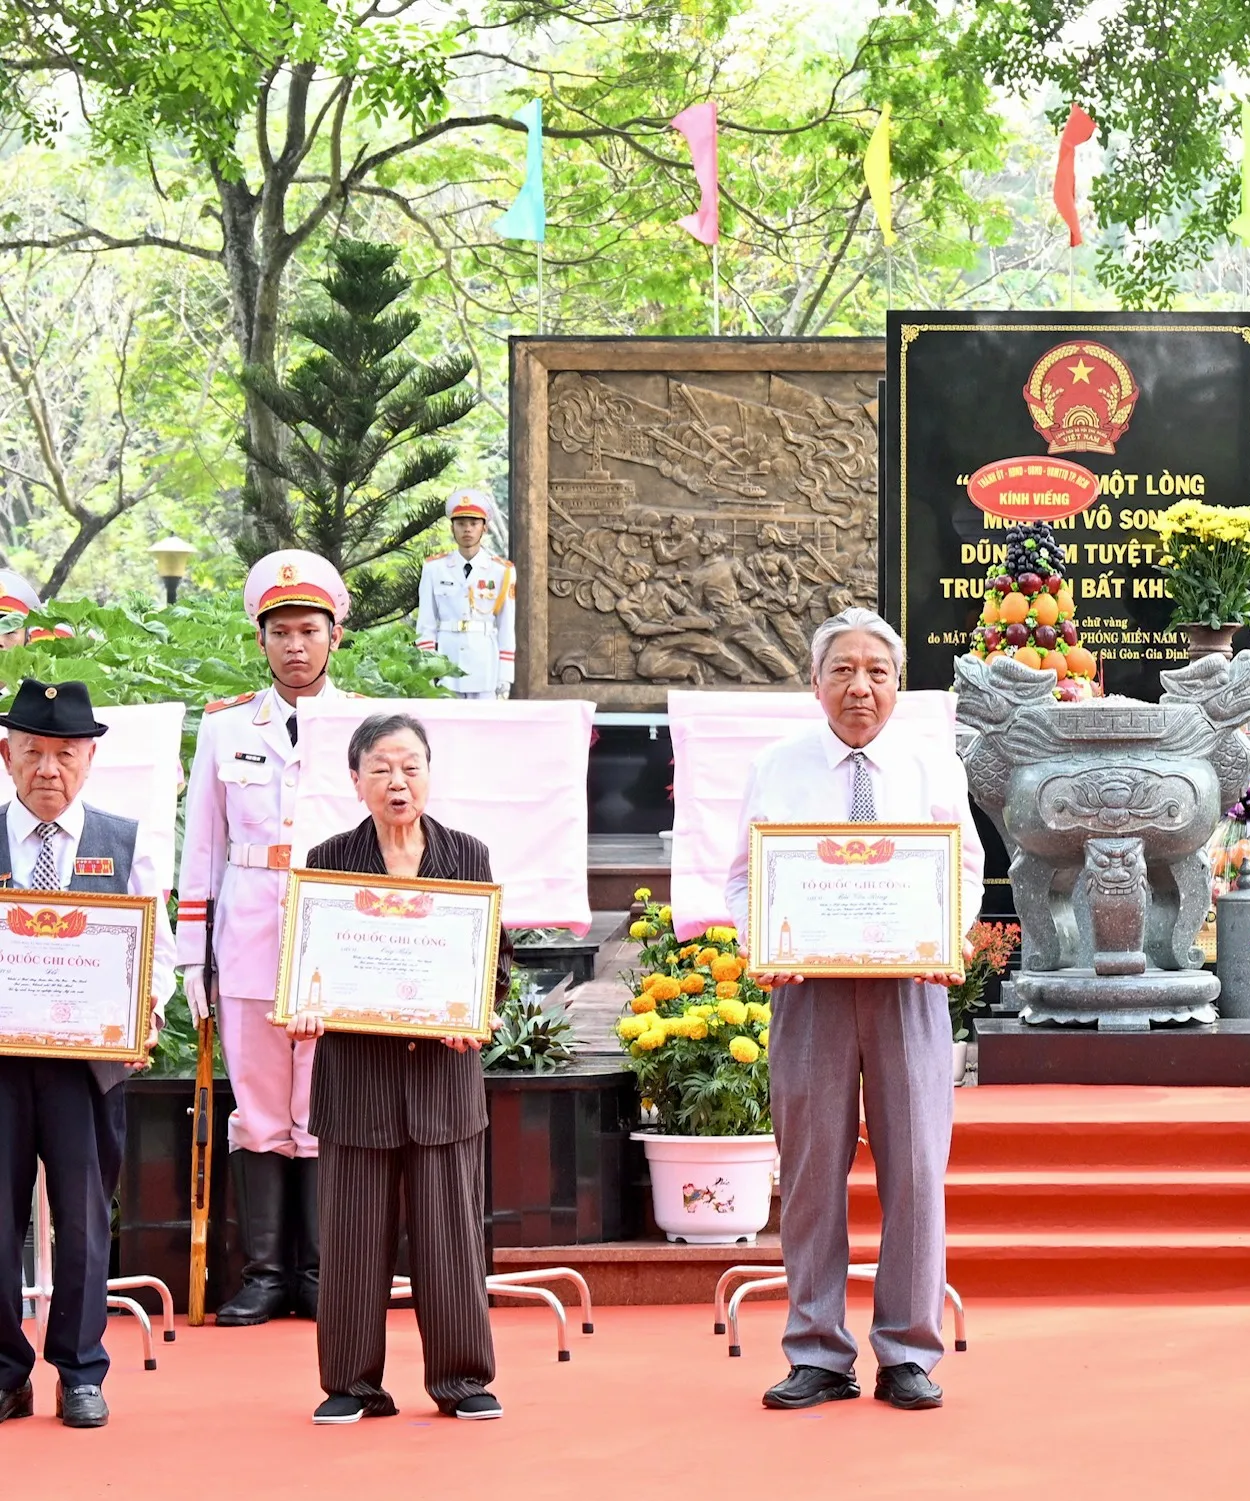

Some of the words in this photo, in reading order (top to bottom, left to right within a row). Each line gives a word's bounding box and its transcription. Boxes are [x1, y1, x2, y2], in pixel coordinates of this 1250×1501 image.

[1083, 434, 1100, 443] NAM
[1146, 470, 1205, 496] LÒNG
[999, 489, 1030, 505] KÍNH
[1033, 488, 1070, 505] VIẾNG
[1082, 504, 1112, 530] VÔ
[1119, 509, 1164, 530] SON
[961, 538, 1008, 564] DŨN
[1084, 538, 1156, 568] TUYỆT
[940, 578, 986, 599] TRU
[1081, 571, 1125, 599] BẤT
[1082, 616, 1102, 628] chữ
[1103, 616, 1129, 630] vàng
[927, 632, 941, 644] do
[1080, 629, 1119, 644] PHÓNG
[1121, 627, 1150, 644] MIỀN
[1101, 648, 1117, 660] Sài
[389, 935, 410, 945] GHI
[413, 935, 446, 947] CÔNG
[7, 950, 41, 965] QUỐC
[43, 956, 64, 966] GHI
[67, 955, 100, 968] CÔNG
